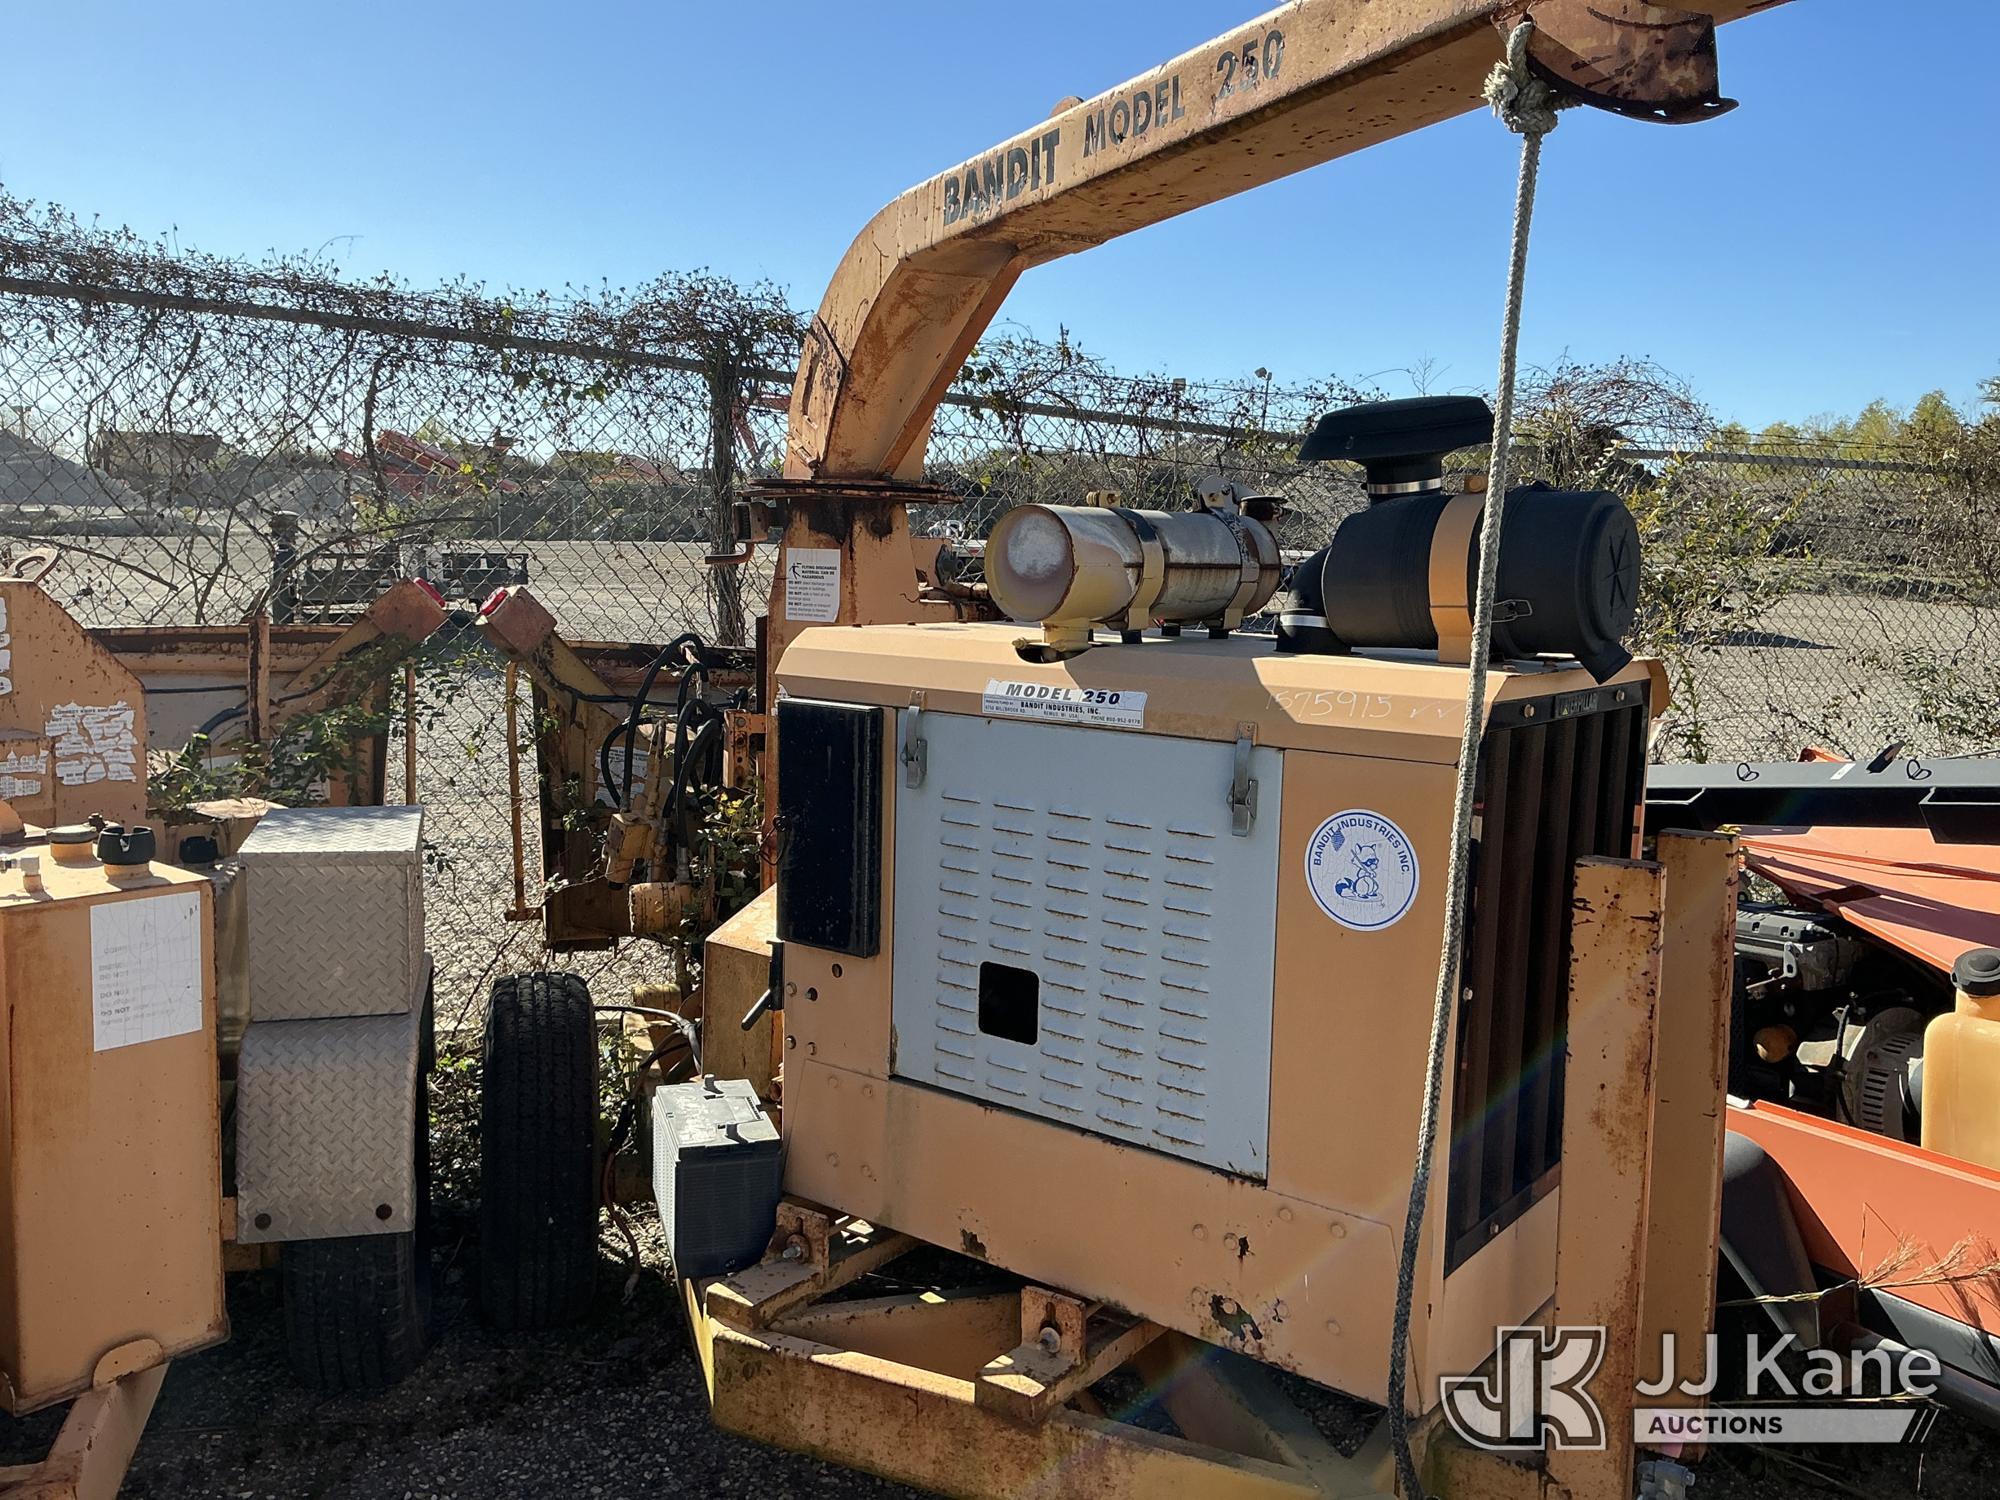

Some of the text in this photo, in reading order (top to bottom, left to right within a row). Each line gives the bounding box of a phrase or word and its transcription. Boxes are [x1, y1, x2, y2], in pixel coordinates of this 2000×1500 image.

[943, 30, 1285, 227] BANDIT MODEL 250
[1005, 683, 1121, 705] MODEL 250
[1021, 701, 1044, 709] BANDIT
[1045, 703, 1085, 714] INDUSTRIES,
[1313, 818, 1410, 875] BANDIT INDUSTRIES INC.
[114, 1006, 130, 1015] NOT
